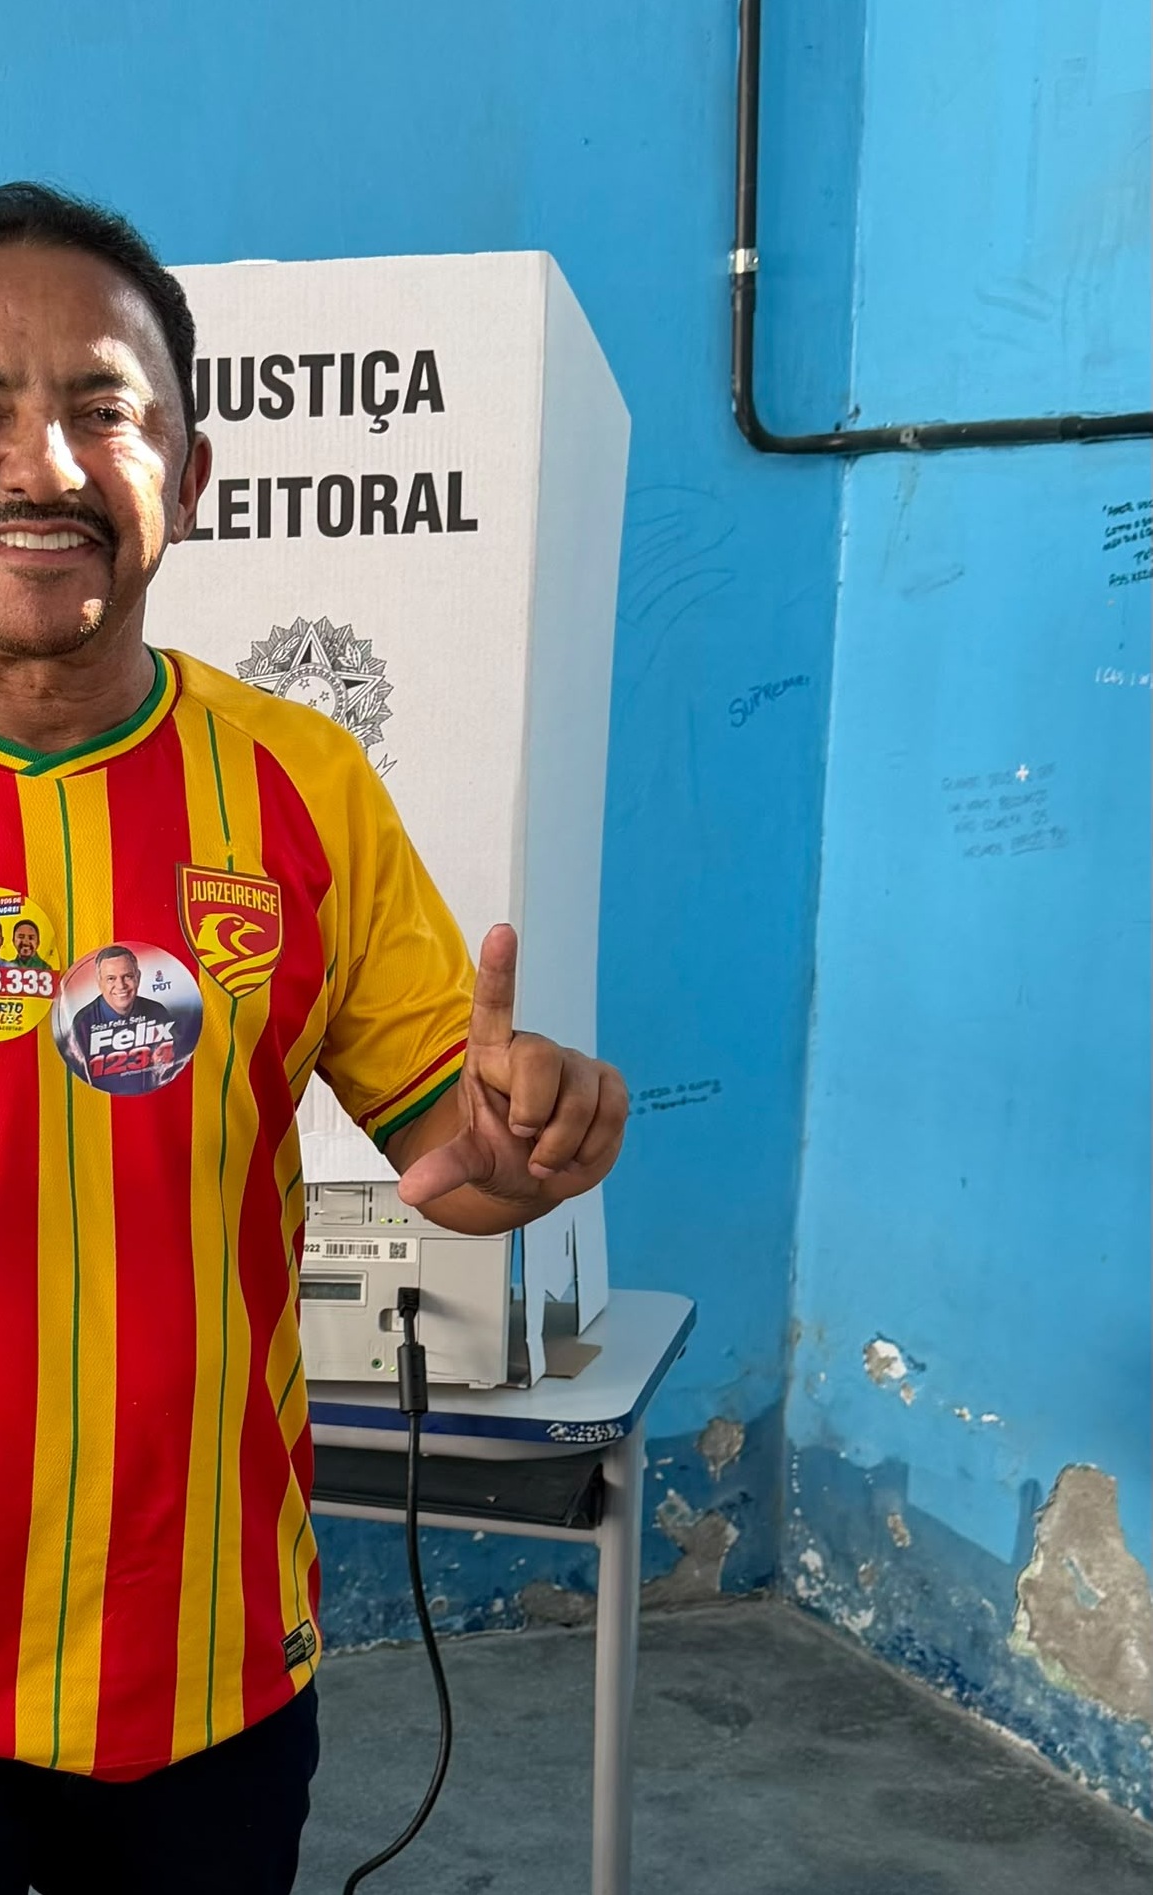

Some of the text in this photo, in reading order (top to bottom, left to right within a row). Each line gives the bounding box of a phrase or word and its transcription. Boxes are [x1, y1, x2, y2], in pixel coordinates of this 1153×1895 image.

[196, 350, 445, 434] JUSTIÇA
[184, 471, 478, 541] EITORAL
[190, 881, 278, 916] JUAZEIRENSE
[152, 981, 172, 993] PDT
[304, 1243, 321, 1253] 022
